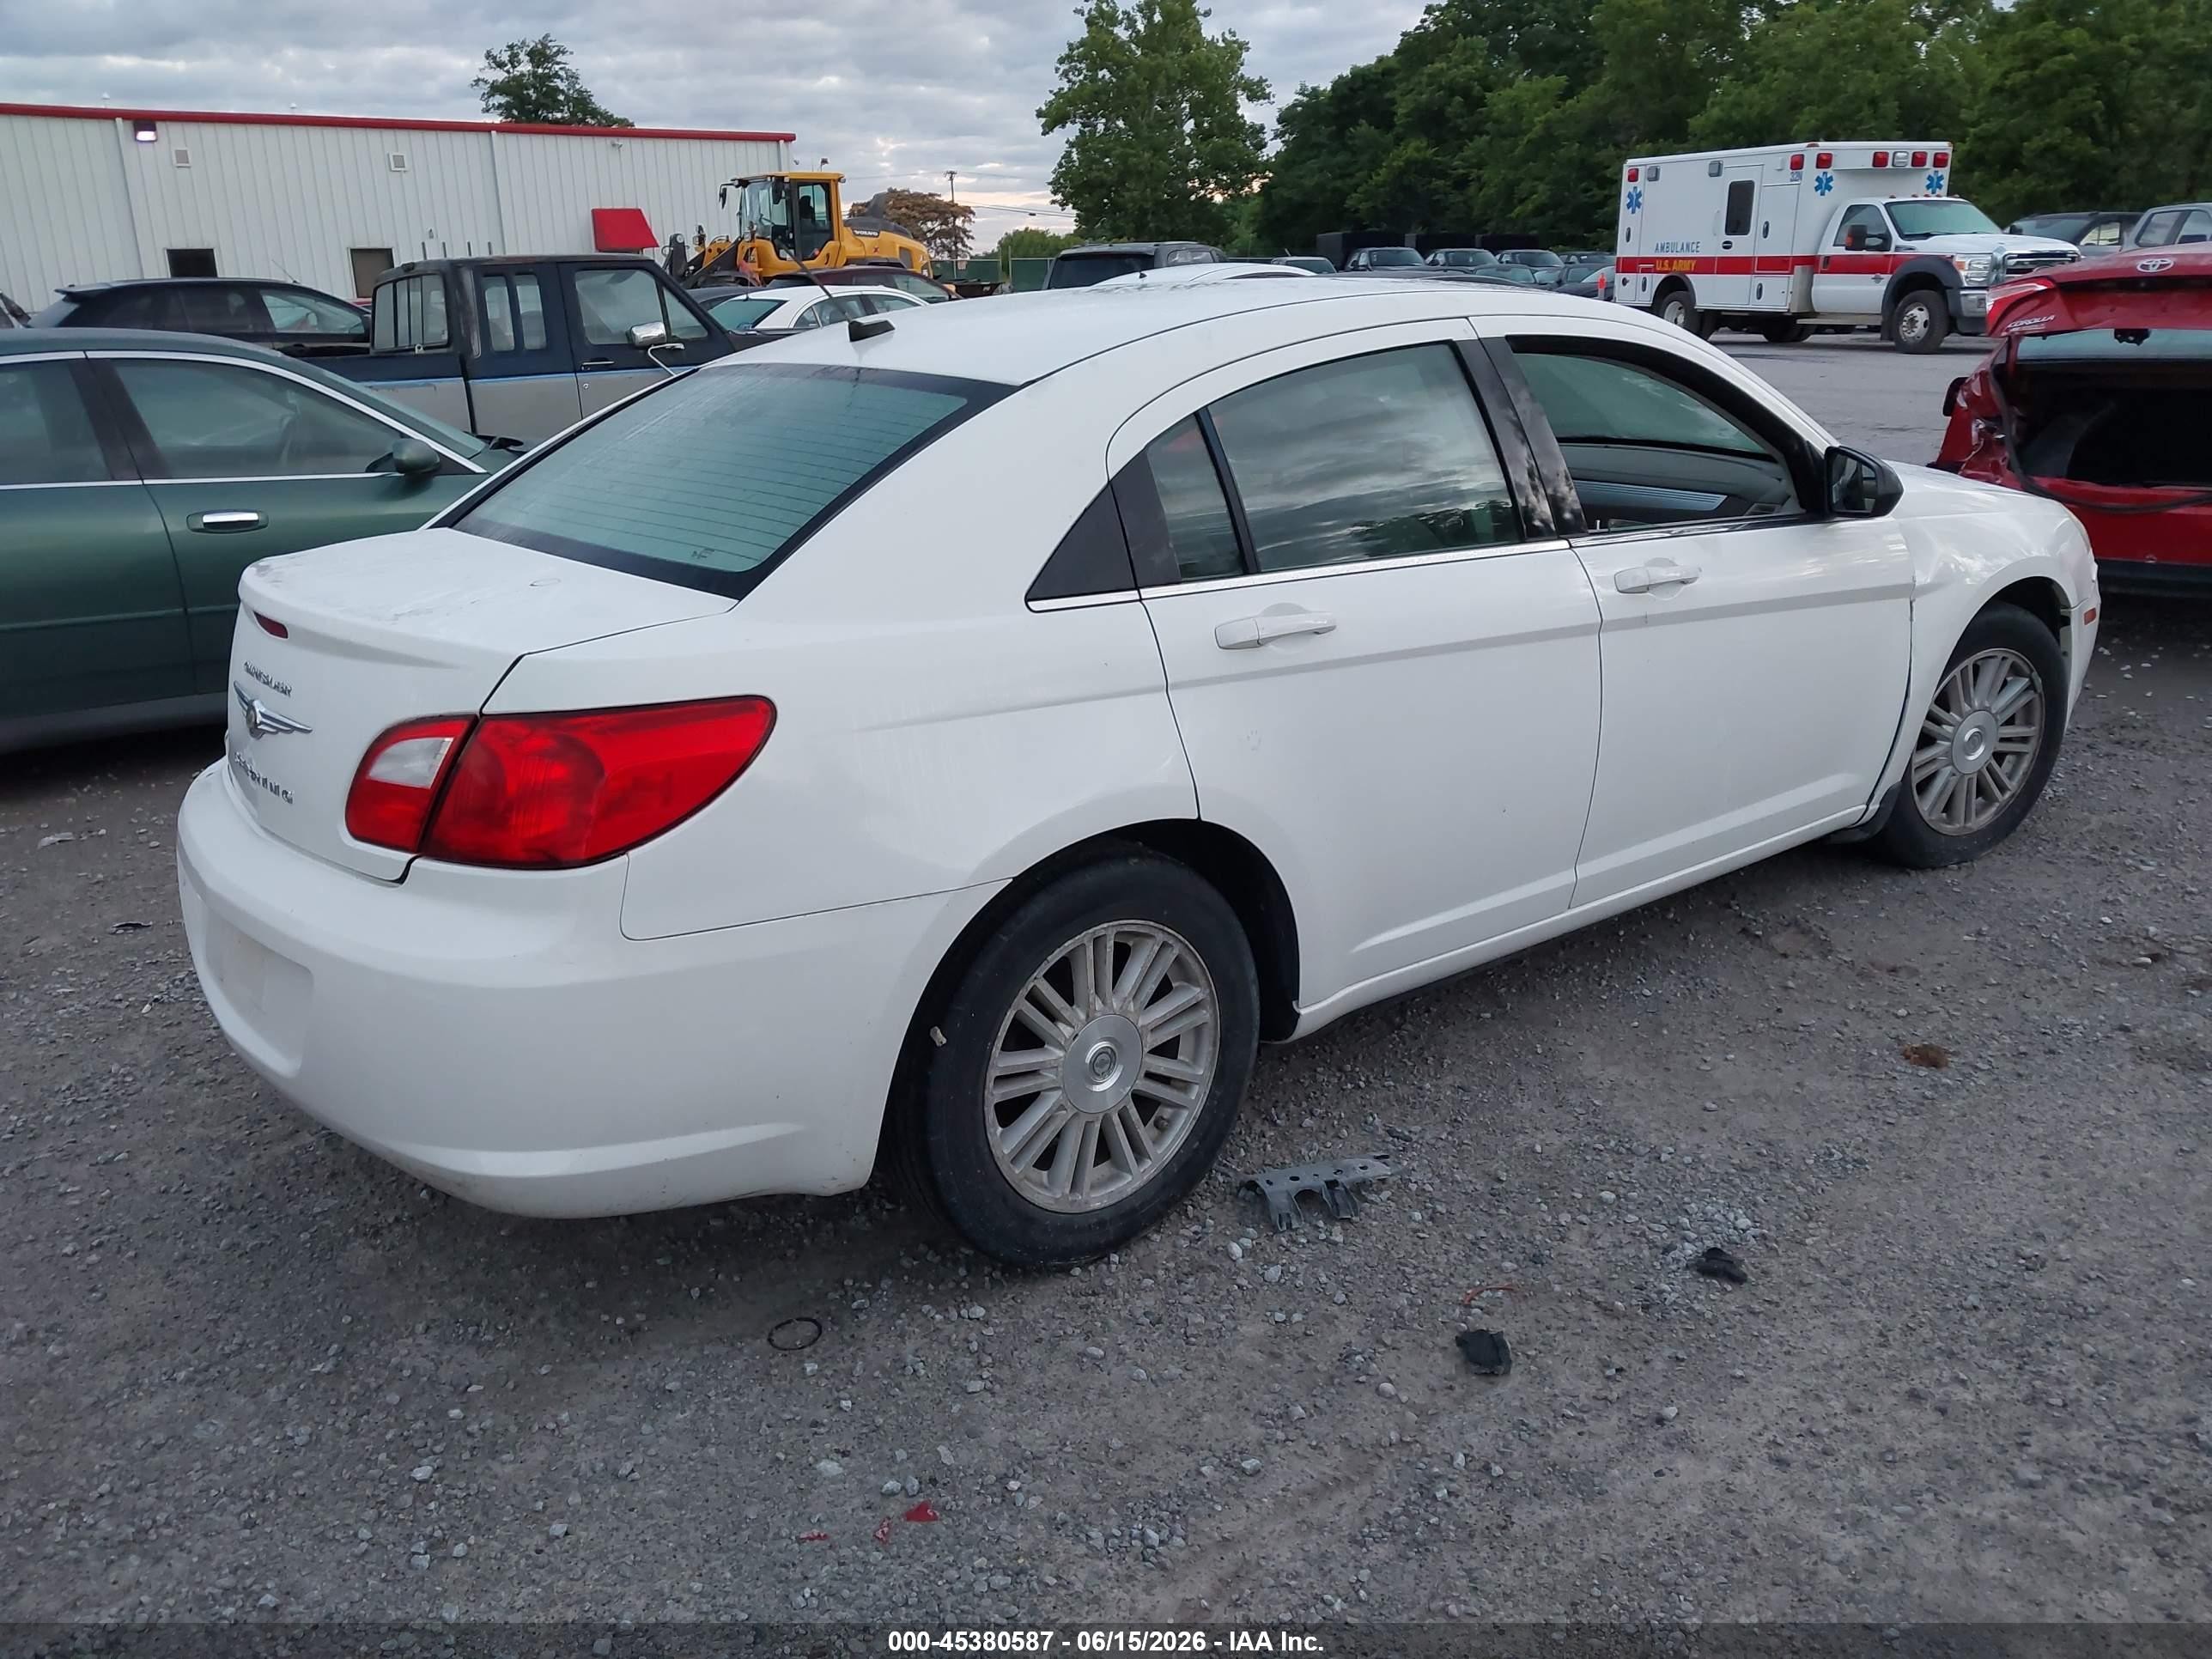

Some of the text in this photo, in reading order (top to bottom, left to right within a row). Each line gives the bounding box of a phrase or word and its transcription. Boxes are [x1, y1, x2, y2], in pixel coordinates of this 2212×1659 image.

[1655, 241, 1701, 253] AMBULANCE
[1672, 259, 1697, 271] ARMY
[2006, 315, 2056, 329] COROLLA
